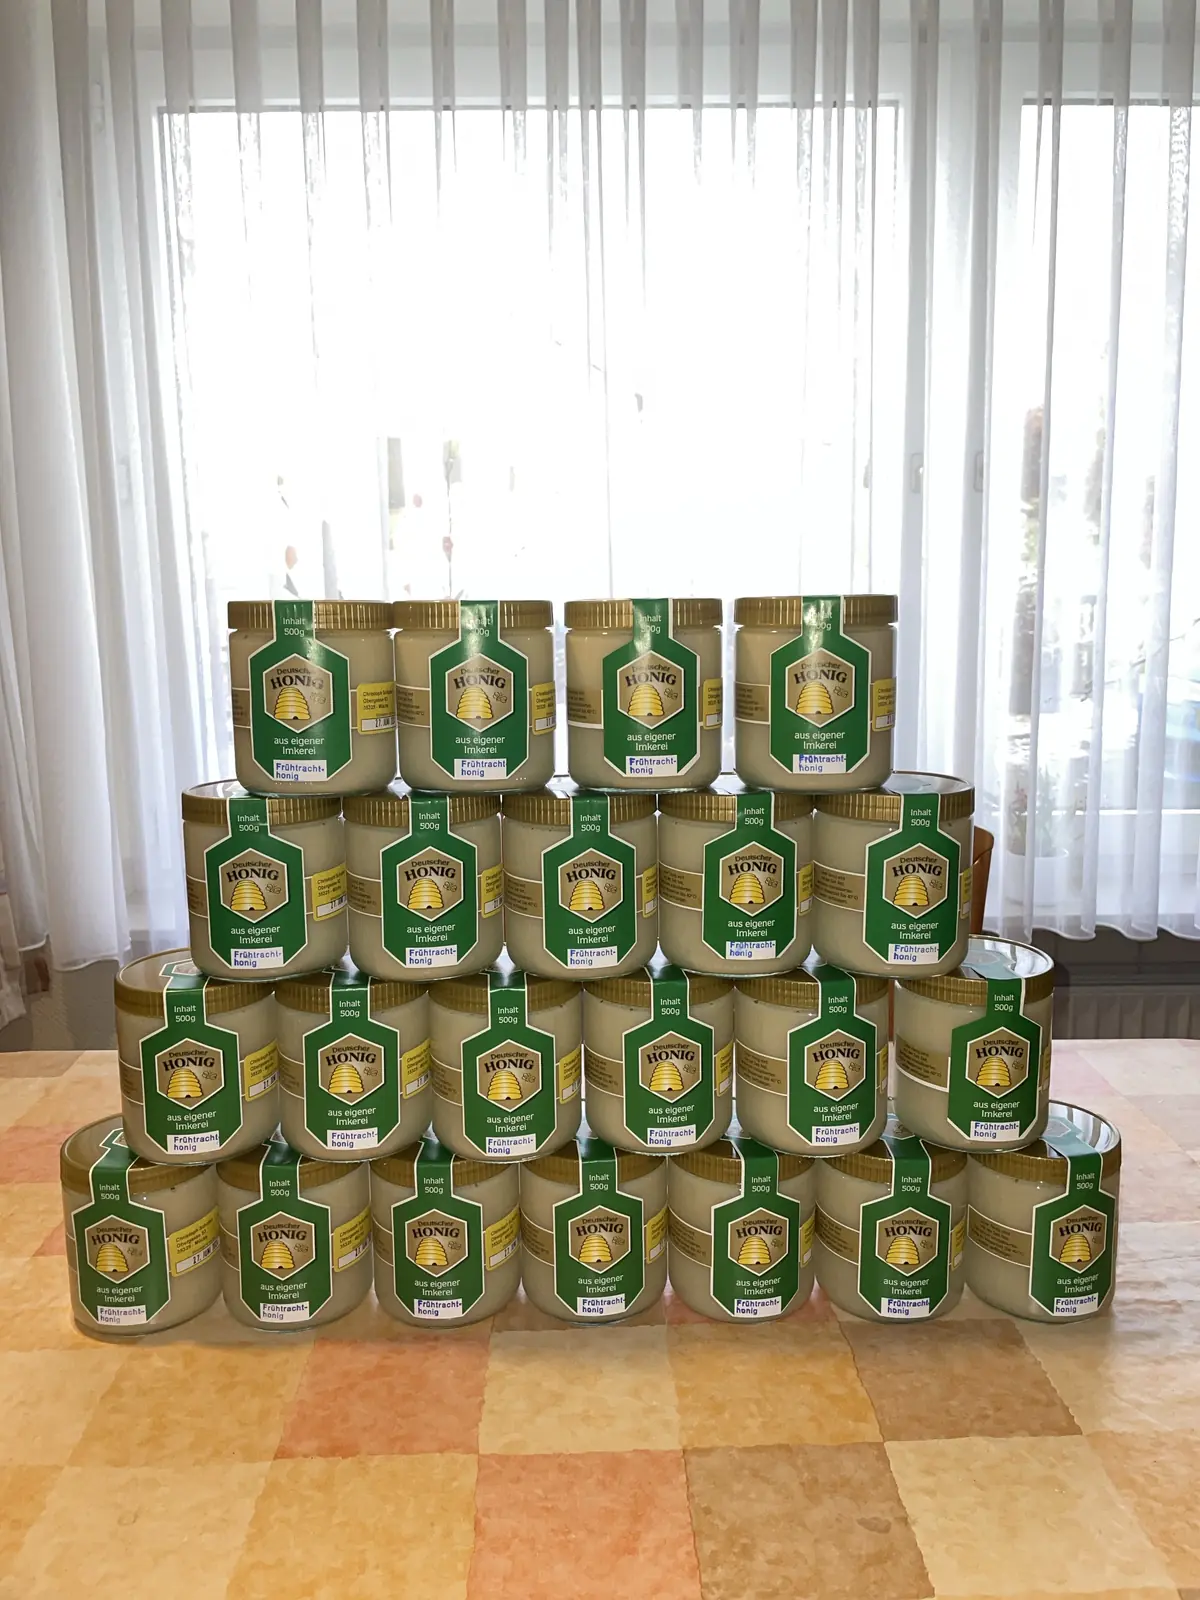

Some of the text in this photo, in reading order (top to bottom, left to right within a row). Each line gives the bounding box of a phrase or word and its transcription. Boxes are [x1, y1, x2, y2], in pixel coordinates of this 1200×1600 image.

[283, 617, 305, 625] Inhalt
[284, 628, 304, 637] 500g
[625, 672, 676, 687] HONIG
[794, 670, 847, 684] HONIG
[271, 675, 324, 689] HONIG
[453, 675, 506, 689] HONIG
[645, 733, 676, 742] eigener
[812, 731, 845, 741] eigener
[291, 737, 324, 746] eigener
[473, 737, 505, 746] eigener
[804, 741, 837, 749] Imkerei
[283, 747, 316, 755] Imkerei
[465, 746, 497, 754] Imkerei
[636, 742, 668, 751] Imkerei
[630, 766, 653, 774] honig
[276, 772, 298, 781] honig
[745, 818, 764, 826] 500g
[911, 819, 930, 827] 500g
[900, 856, 937, 864] Deutscher
[728, 862, 777, 875] HONIG
[892, 864, 942, 877] HONIG
[226, 868, 279, 882] HONIG
[404, 866, 456, 881] HONIG
[566, 868, 616, 882] HONIG
[424, 924, 455, 934] eigener
[745, 920, 775, 929] eigener
[909, 922, 938, 931] eigener
[248, 926, 280, 936] eigener
[586, 926, 616, 935] eigener
[737, 929, 767, 937] Imkerei
[240, 935, 272, 944] Imkerei
[416, 934, 447, 942] Imkerei
[577, 936, 609, 944] Imkerei
[730, 949, 752, 958] honig
[234, 959, 257, 967] honig
[409, 957, 432, 965] honig
[995, 1004, 1013, 1012] 500g
[340, 1010, 360, 1018] 500g
[176, 1015, 195, 1023] 500g
[812, 1049, 860, 1062] HONIG
[976, 1046, 1024, 1058] HONIG
[326, 1052, 376, 1066] HONIG
[647, 1050, 695, 1064] HONIG
[162, 1057, 215, 1071] HONIG
[484, 1059, 534, 1073] HONIG
[665, 1105, 694, 1115] eigener
[831, 1103, 858, 1113] eigener
[991, 1102, 1020, 1110] eigener
[184, 1111, 216, 1122] eigener
[345, 1108, 376, 1117] eigener
[982, 1110, 1012, 1118] Imkerei
[336, 1117, 368, 1125] Imkerei
[504, 1114, 534, 1124] eigener
[657, 1115, 687, 1123] Imkerei
[822, 1113, 851, 1122] Imkerei
[176, 1121, 208, 1130] Imkerei
[496, 1123, 526, 1132] Imkerei
[974, 1130, 996, 1138] honig
[649, 1137, 671, 1145] honig
[816, 1135, 837, 1143] honig
[332, 1140, 354, 1148] honig
[488, 1146, 510, 1154] honig
[590, 1183, 608, 1191] 500g
[1077, 1182, 1093, 1190] 500g
[271, 1189, 289, 1197] 500g
[412, 1227, 460, 1239] HONIG
[576, 1223, 624, 1236] HONIG
[736, 1226, 782, 1238] HONIG
[884, 1226, 932, 1238] HONIG
[1059, 1222, 1102, 1236] HONIG
[91, 1233, 140, 1245] HONIG
[258, 1230, 306, 1242] HONIG
[430, 1280, 460, 1289] eigener
[594, 1275, 623, 1285] eigener
[276, 1283, 307, 1292] eigener
[586, 1284, 616, 1293] Imkerei
[744, 1287, 774, 1295] Imkerei
[1065, 1284, 1092, 1293] Imkerei
[105, 1295, 135, 1303] Imkerei
[269, 1292, 299, 1300] Imkerei
